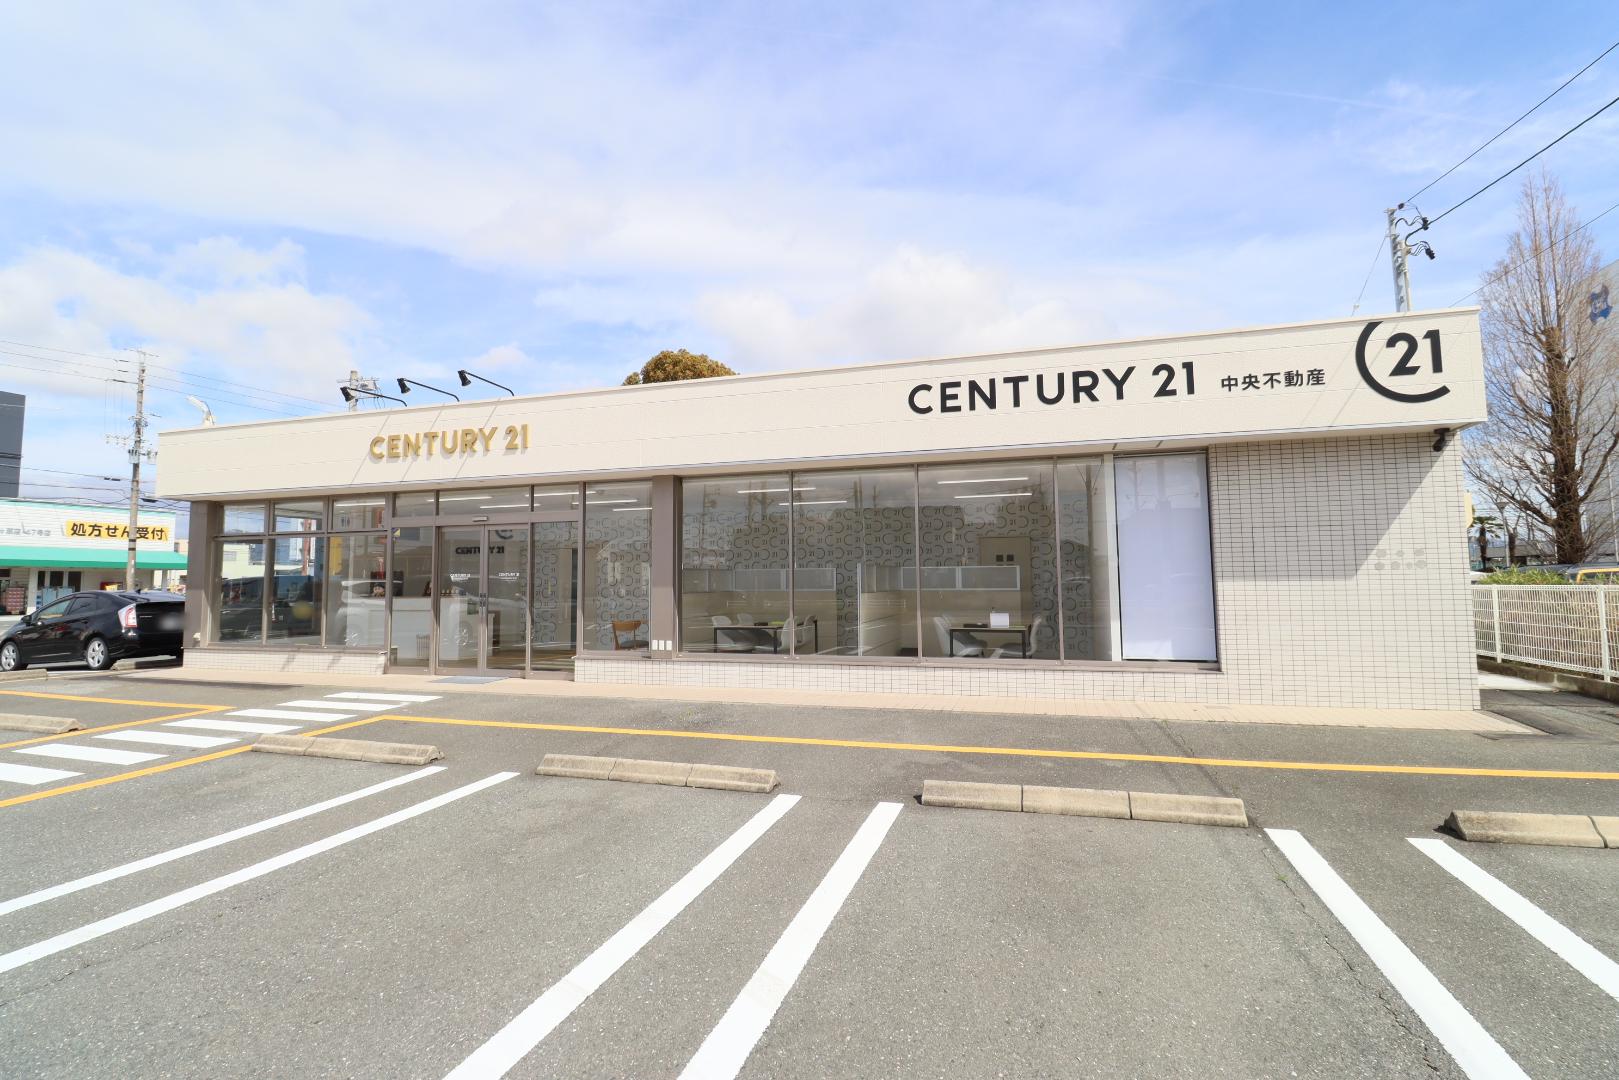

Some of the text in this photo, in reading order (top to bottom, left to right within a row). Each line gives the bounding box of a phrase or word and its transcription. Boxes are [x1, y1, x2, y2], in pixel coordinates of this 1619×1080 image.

[908, 361, 1195, 415] CENTURY 21
[1220, 368, 1326, 393] 中央不動産
[369, 423, 531, 460] CENTURY 21
